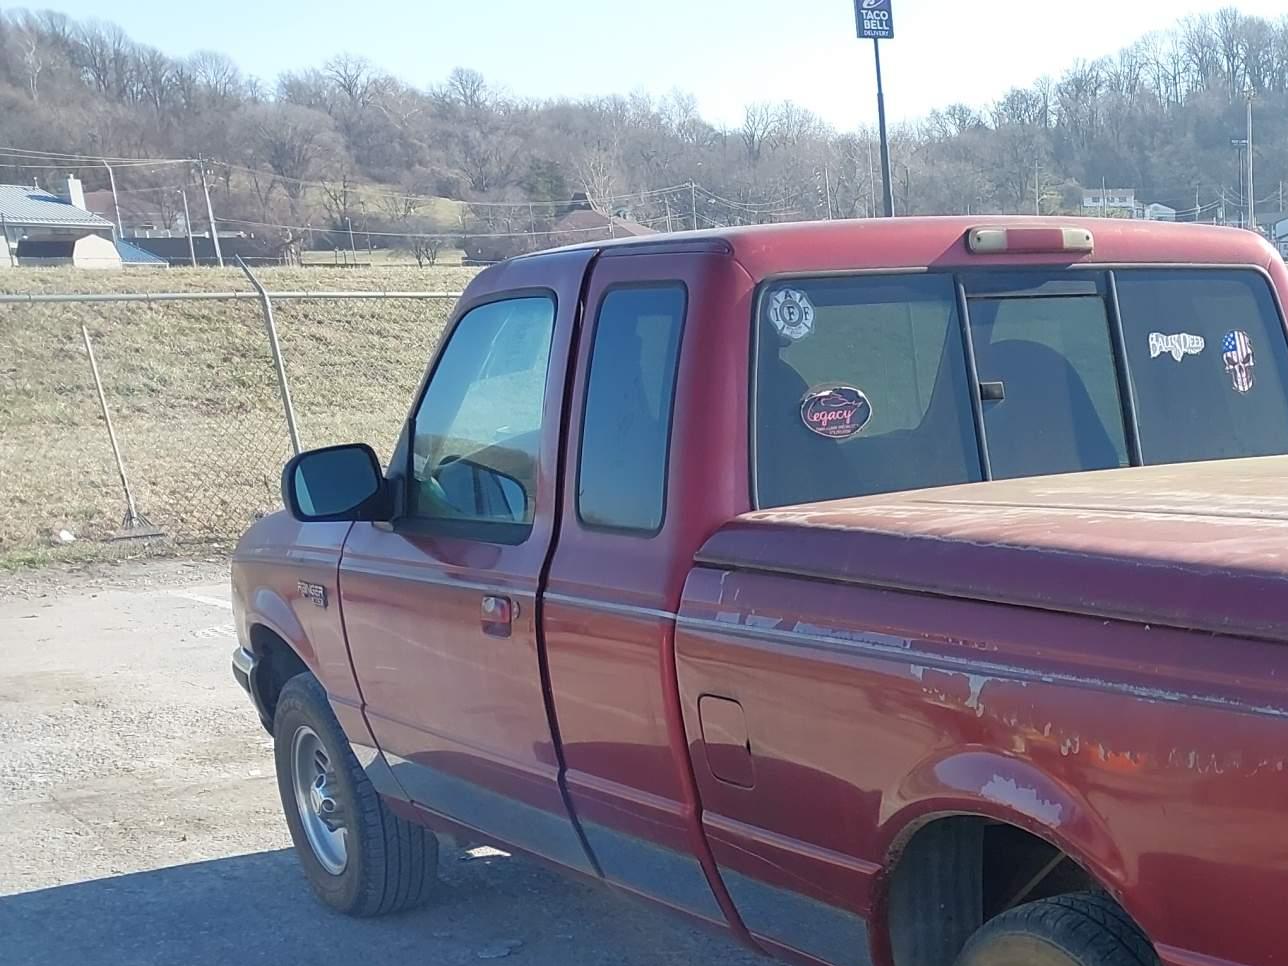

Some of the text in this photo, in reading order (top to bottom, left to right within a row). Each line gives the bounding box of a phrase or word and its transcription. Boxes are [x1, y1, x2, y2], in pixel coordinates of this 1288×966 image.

[861, 10, 888, 20] TACO
[864, 20, 889, 30] BELL
[784, 290, 793, 300] A
[786, 305, 796, 321] F
[807, 398, 855, 426] Legacy
[297, 582, 324, 598] RANGER
